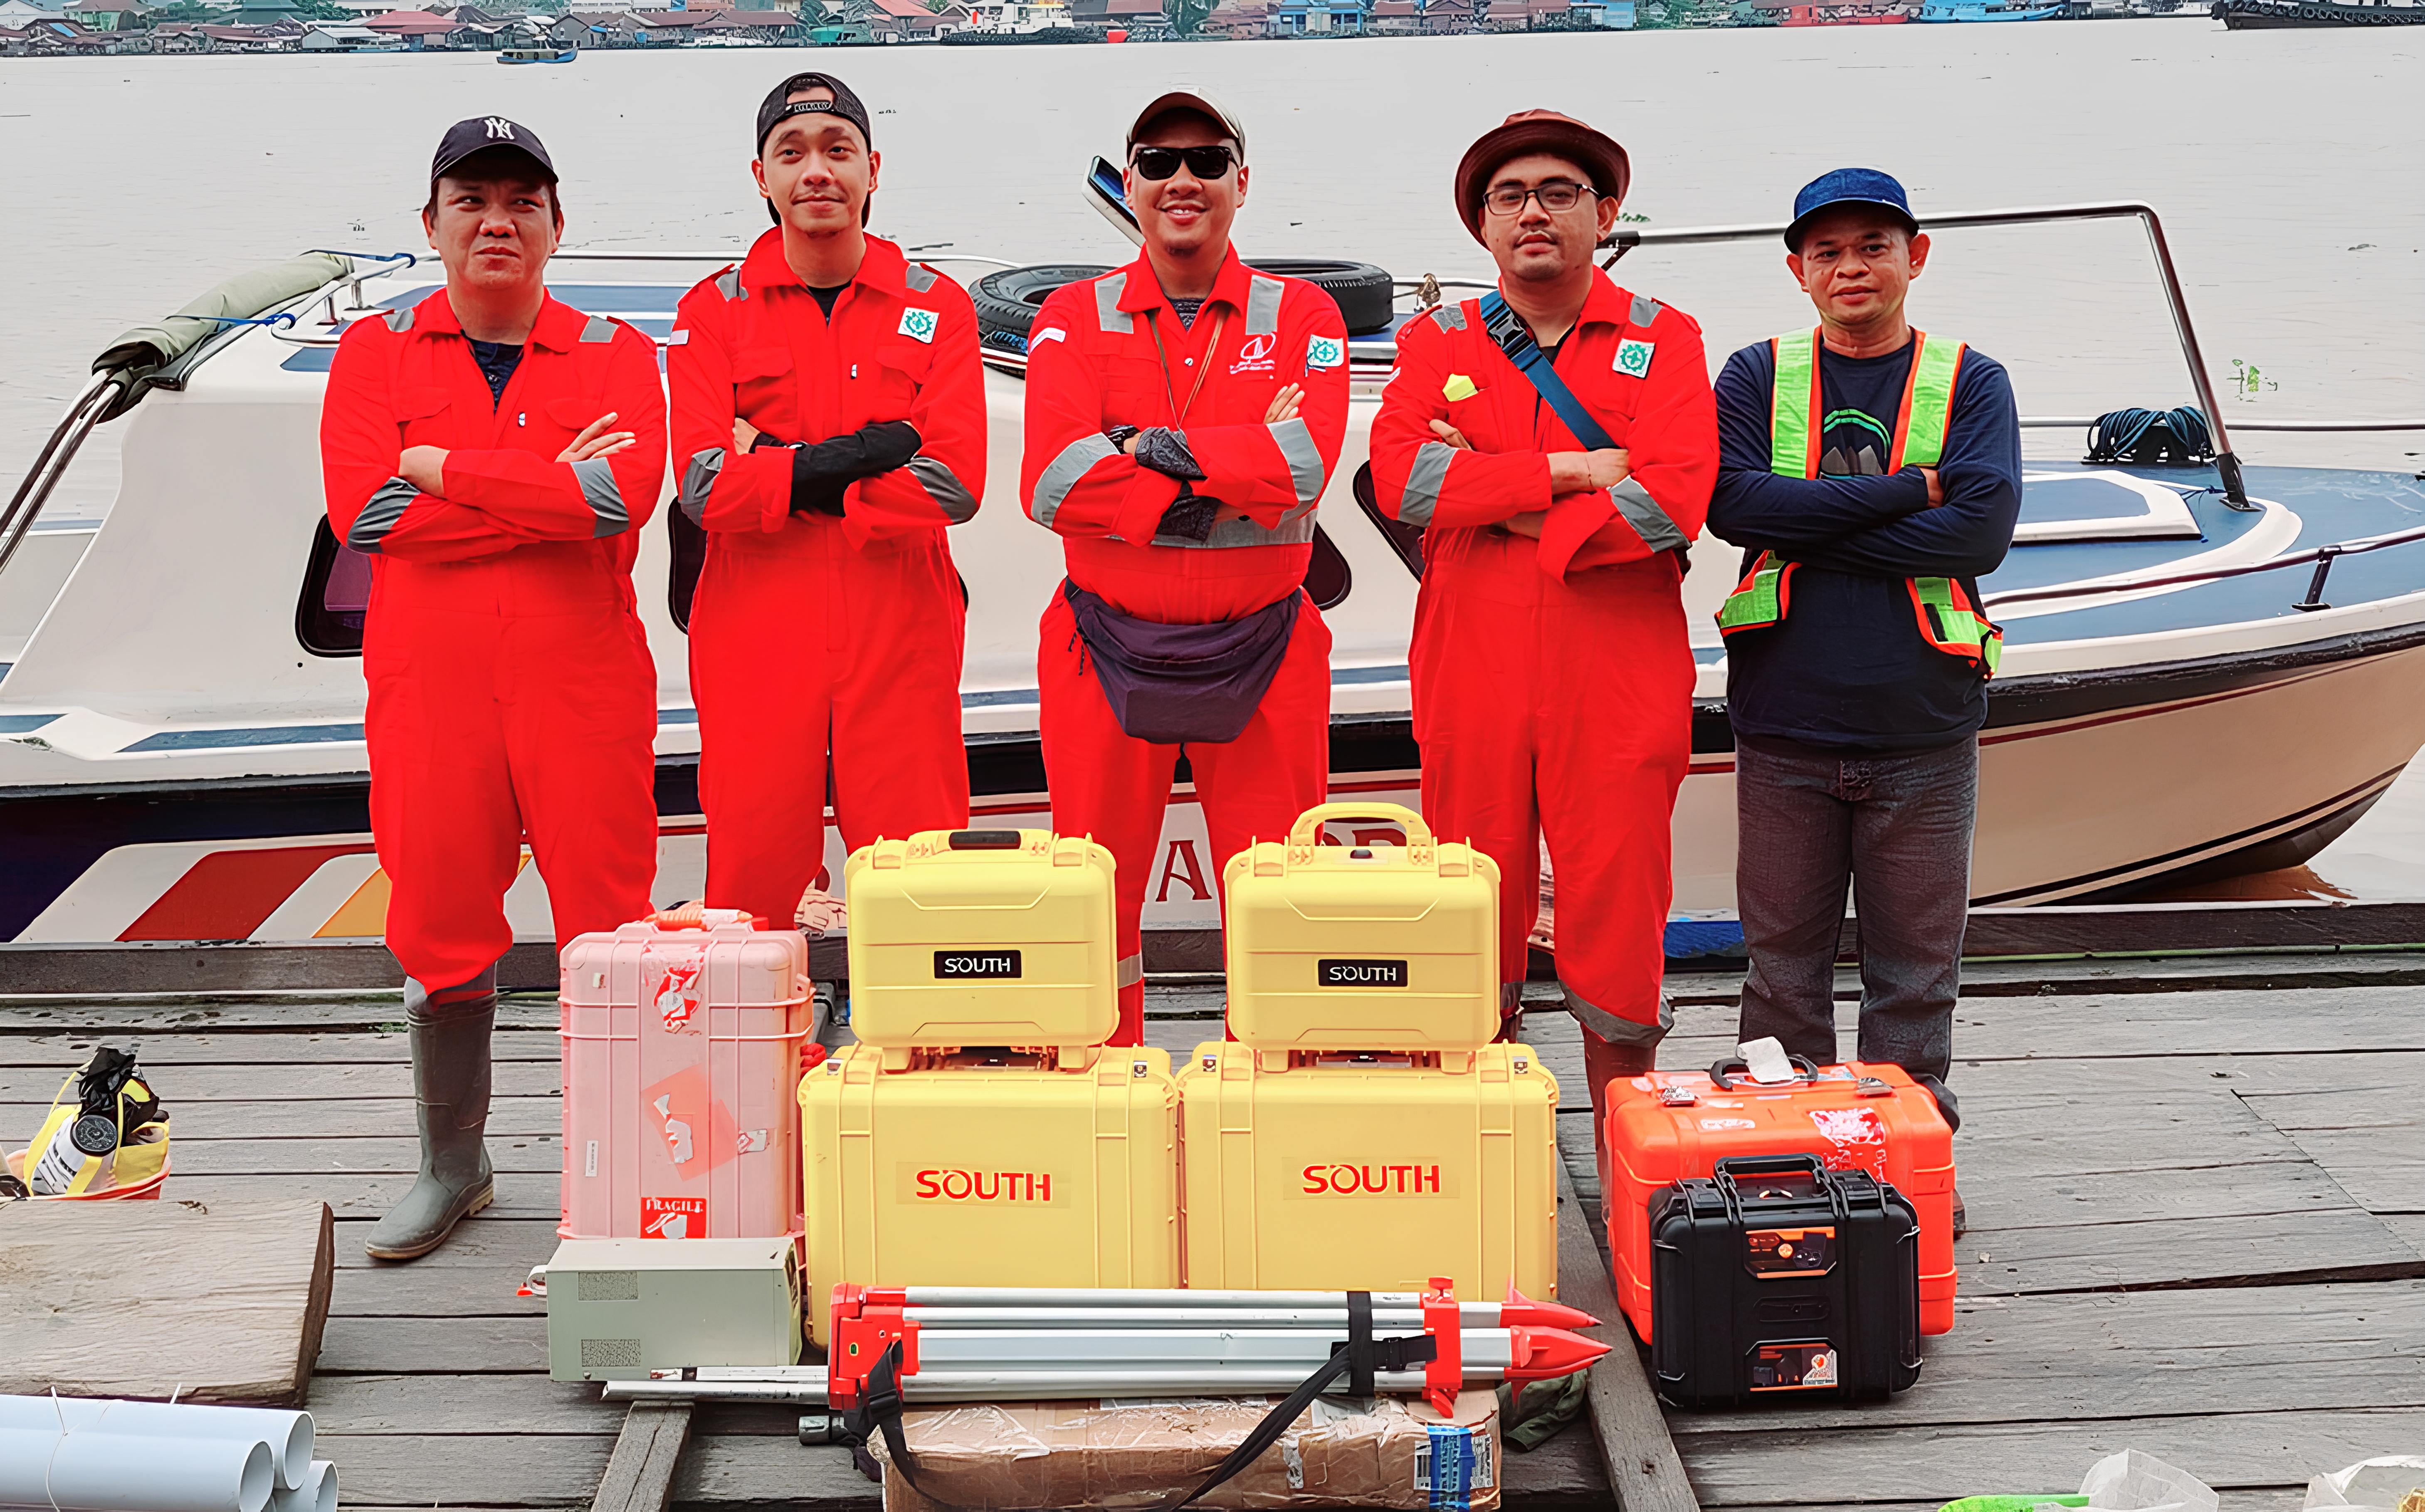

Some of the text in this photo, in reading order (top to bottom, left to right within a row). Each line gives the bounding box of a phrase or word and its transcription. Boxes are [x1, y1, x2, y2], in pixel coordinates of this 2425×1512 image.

[944, 957, 1010, 973] SOUTH
[1329, 966, 1396, 981] SOUTH
[916, 1169, 1051, 1201] SOUTH
[1302, 1164, 1440, 1194] SOUTH
[646, 1198, 704, 1213] FRAGILE
